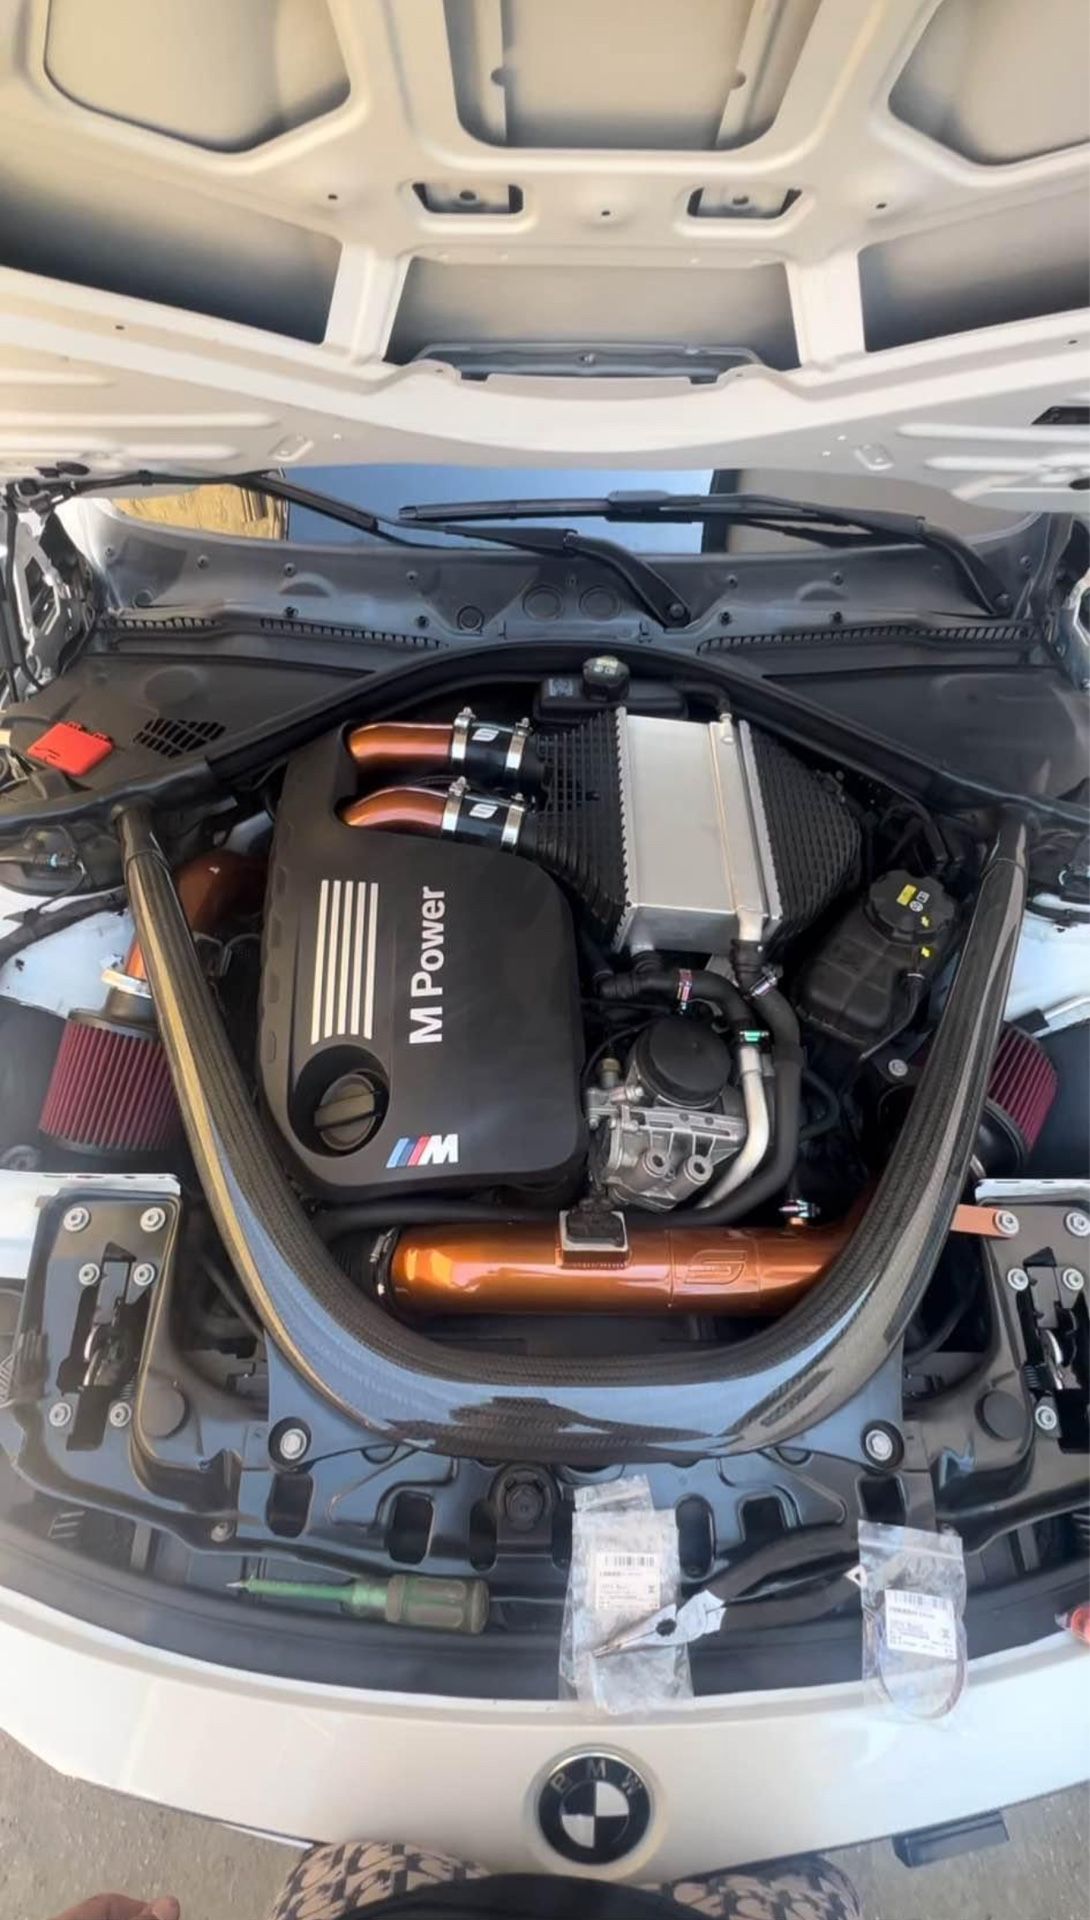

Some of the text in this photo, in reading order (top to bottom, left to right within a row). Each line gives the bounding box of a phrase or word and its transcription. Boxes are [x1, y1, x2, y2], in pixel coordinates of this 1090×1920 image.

[409, 885, 446, 1044] M Power
[549, 1757, 644, 1796] BMW
